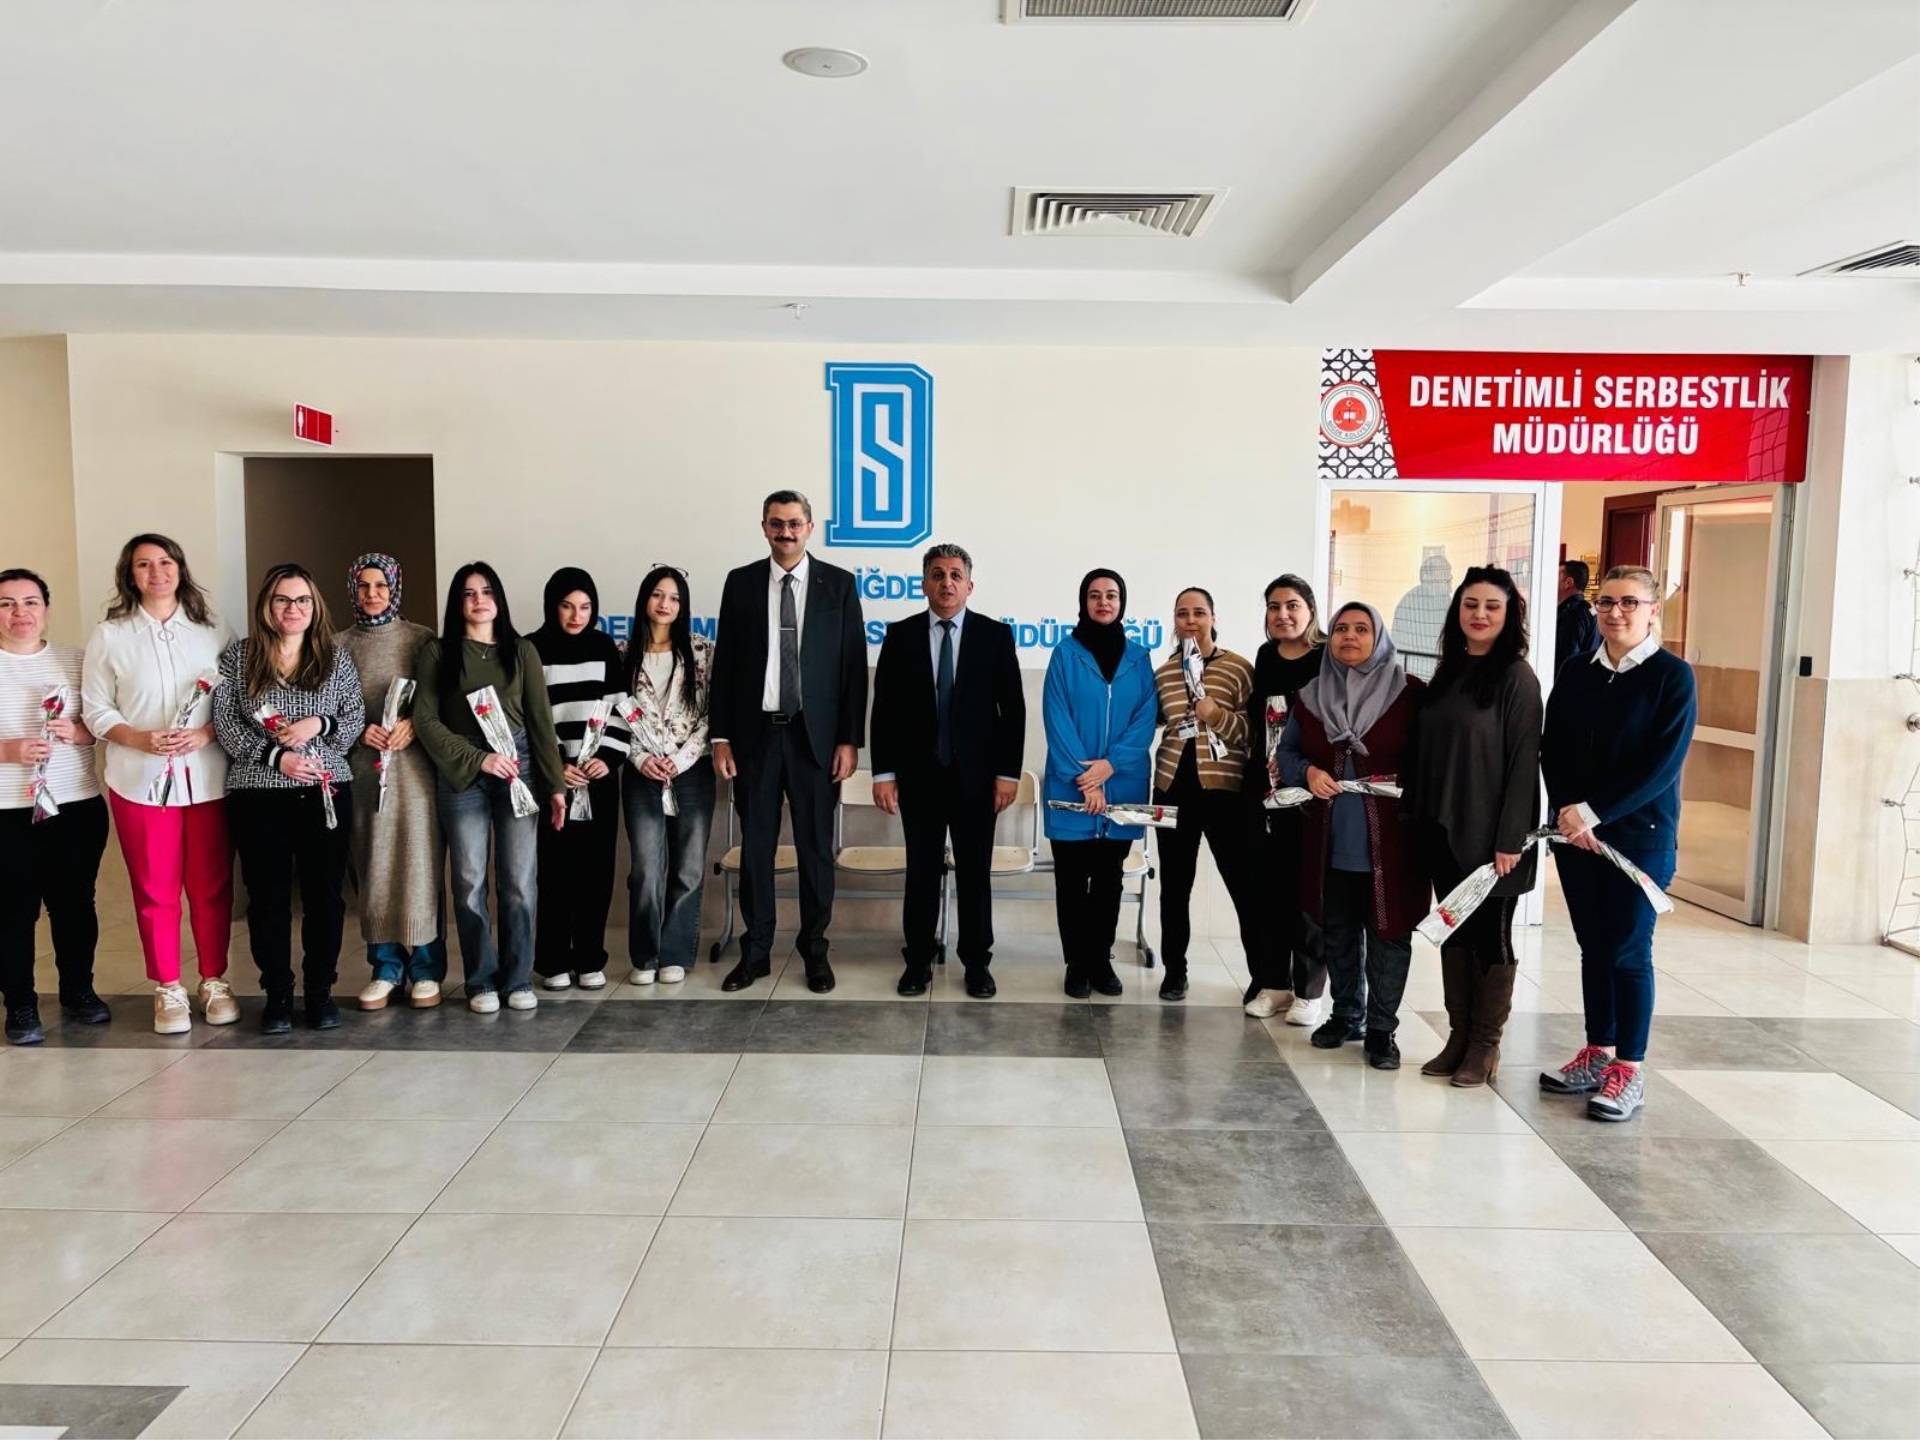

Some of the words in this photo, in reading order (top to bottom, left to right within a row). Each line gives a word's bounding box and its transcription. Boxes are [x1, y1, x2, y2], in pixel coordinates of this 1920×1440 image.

[1409, 368, 1582, 408] DENETİMLİ
[1594, 369, 1791, 409] SERBESTLİK
[1493, 416, 1699, 455] MÜDÜRLÜĞÜ
[855, 567, 926, 600] İĞDE
